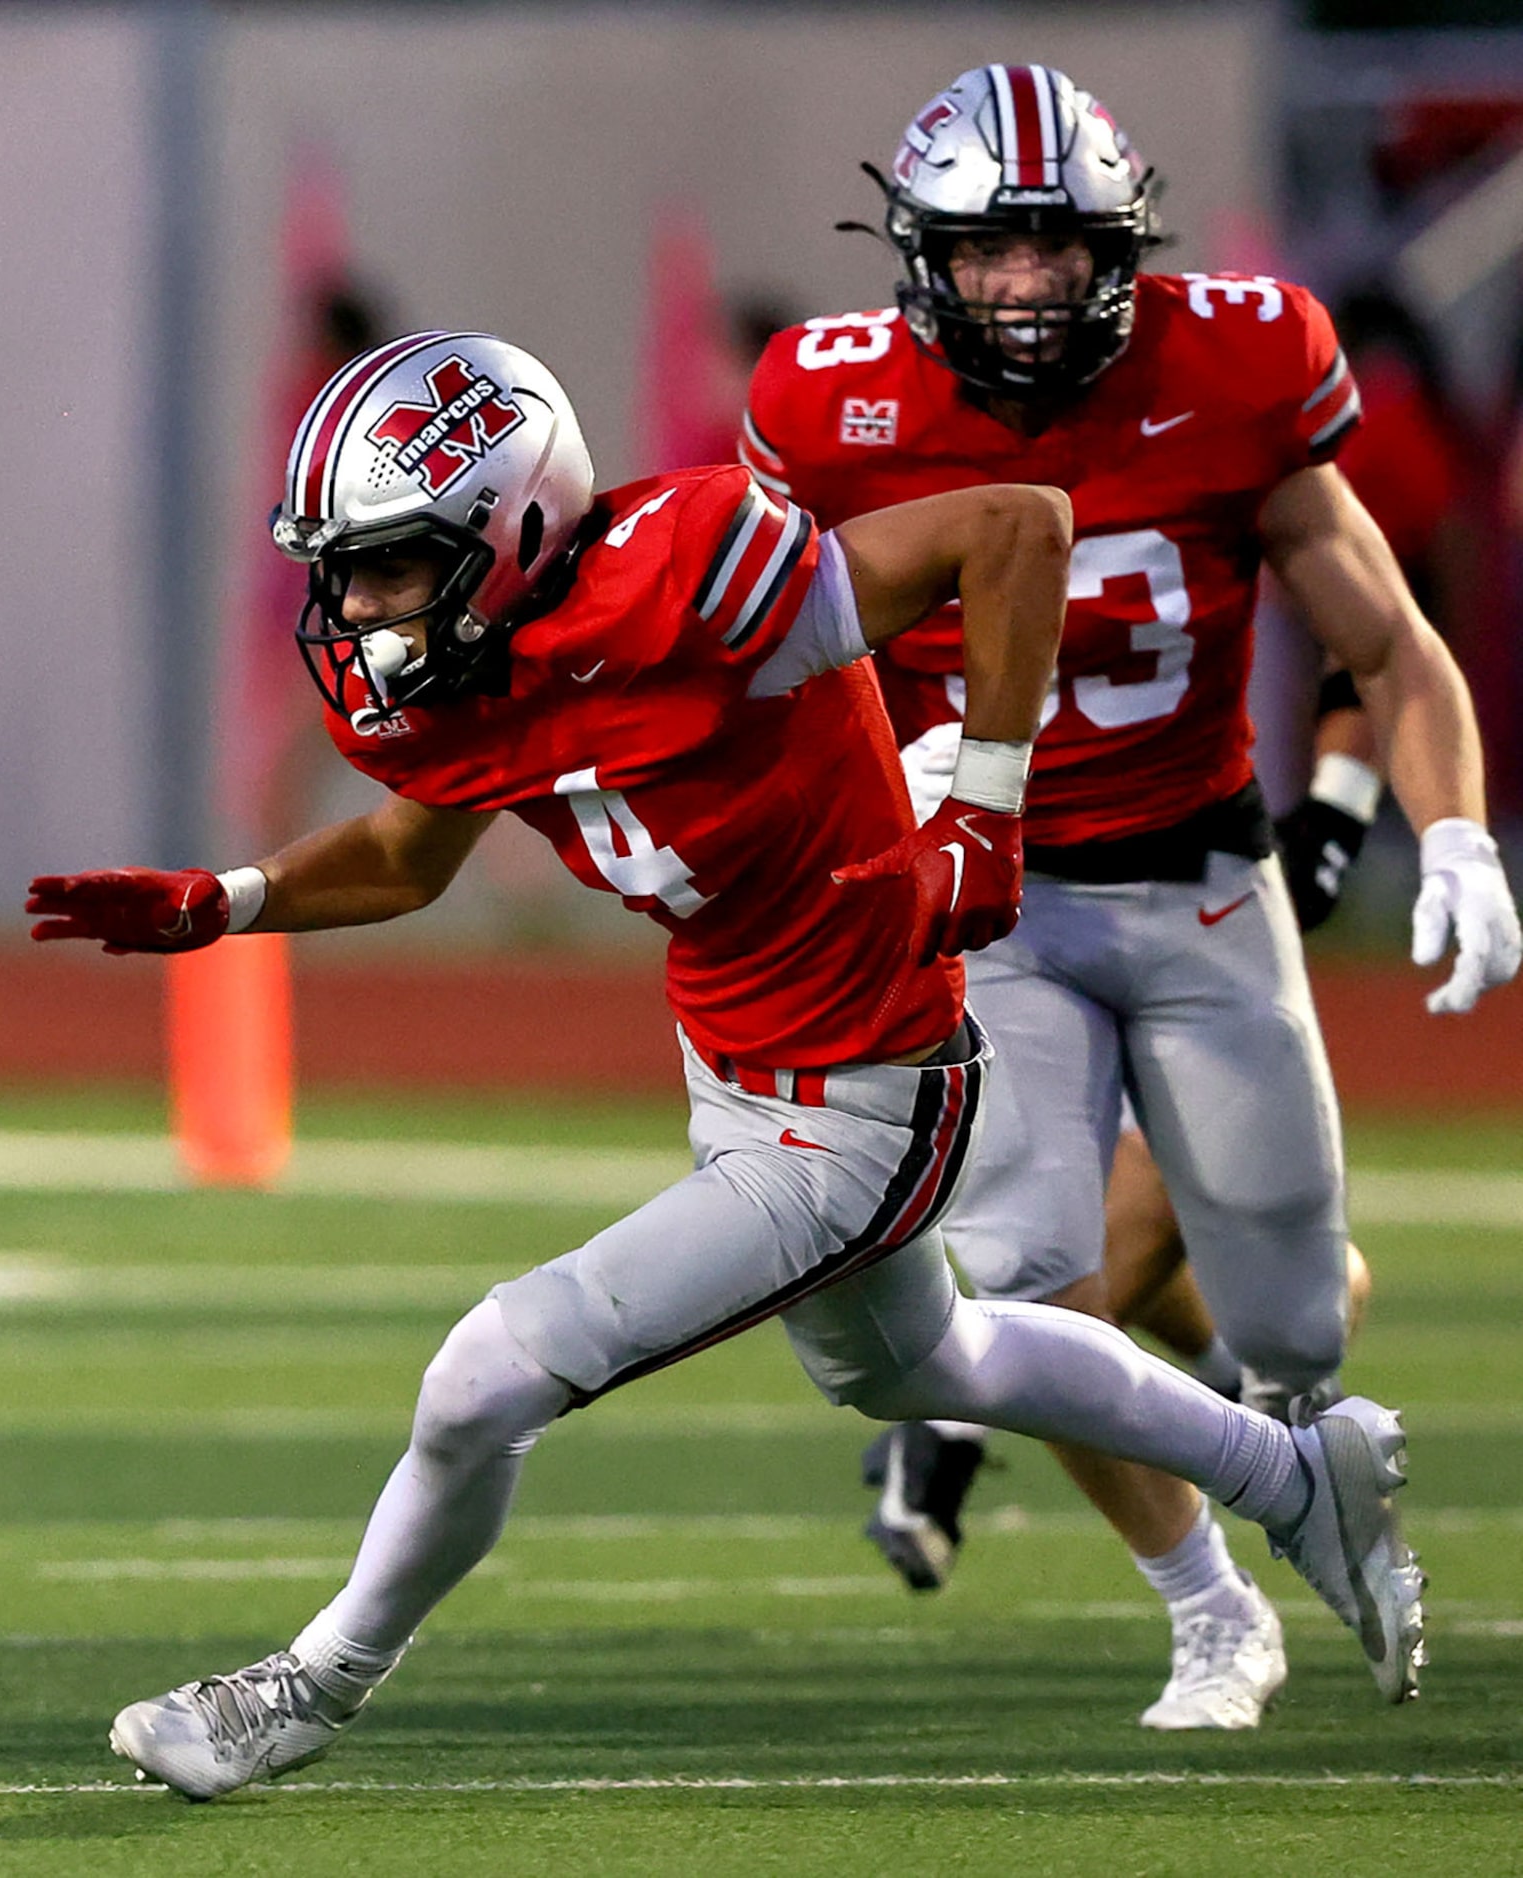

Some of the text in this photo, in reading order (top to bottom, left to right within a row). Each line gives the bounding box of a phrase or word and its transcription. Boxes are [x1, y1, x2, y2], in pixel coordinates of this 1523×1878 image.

[1182, 272, 1282, 322] 3
[396, 379, 495, 469] marcus
[604, 487, 677, 548] 4
[553, 766, 720, 920] 4
